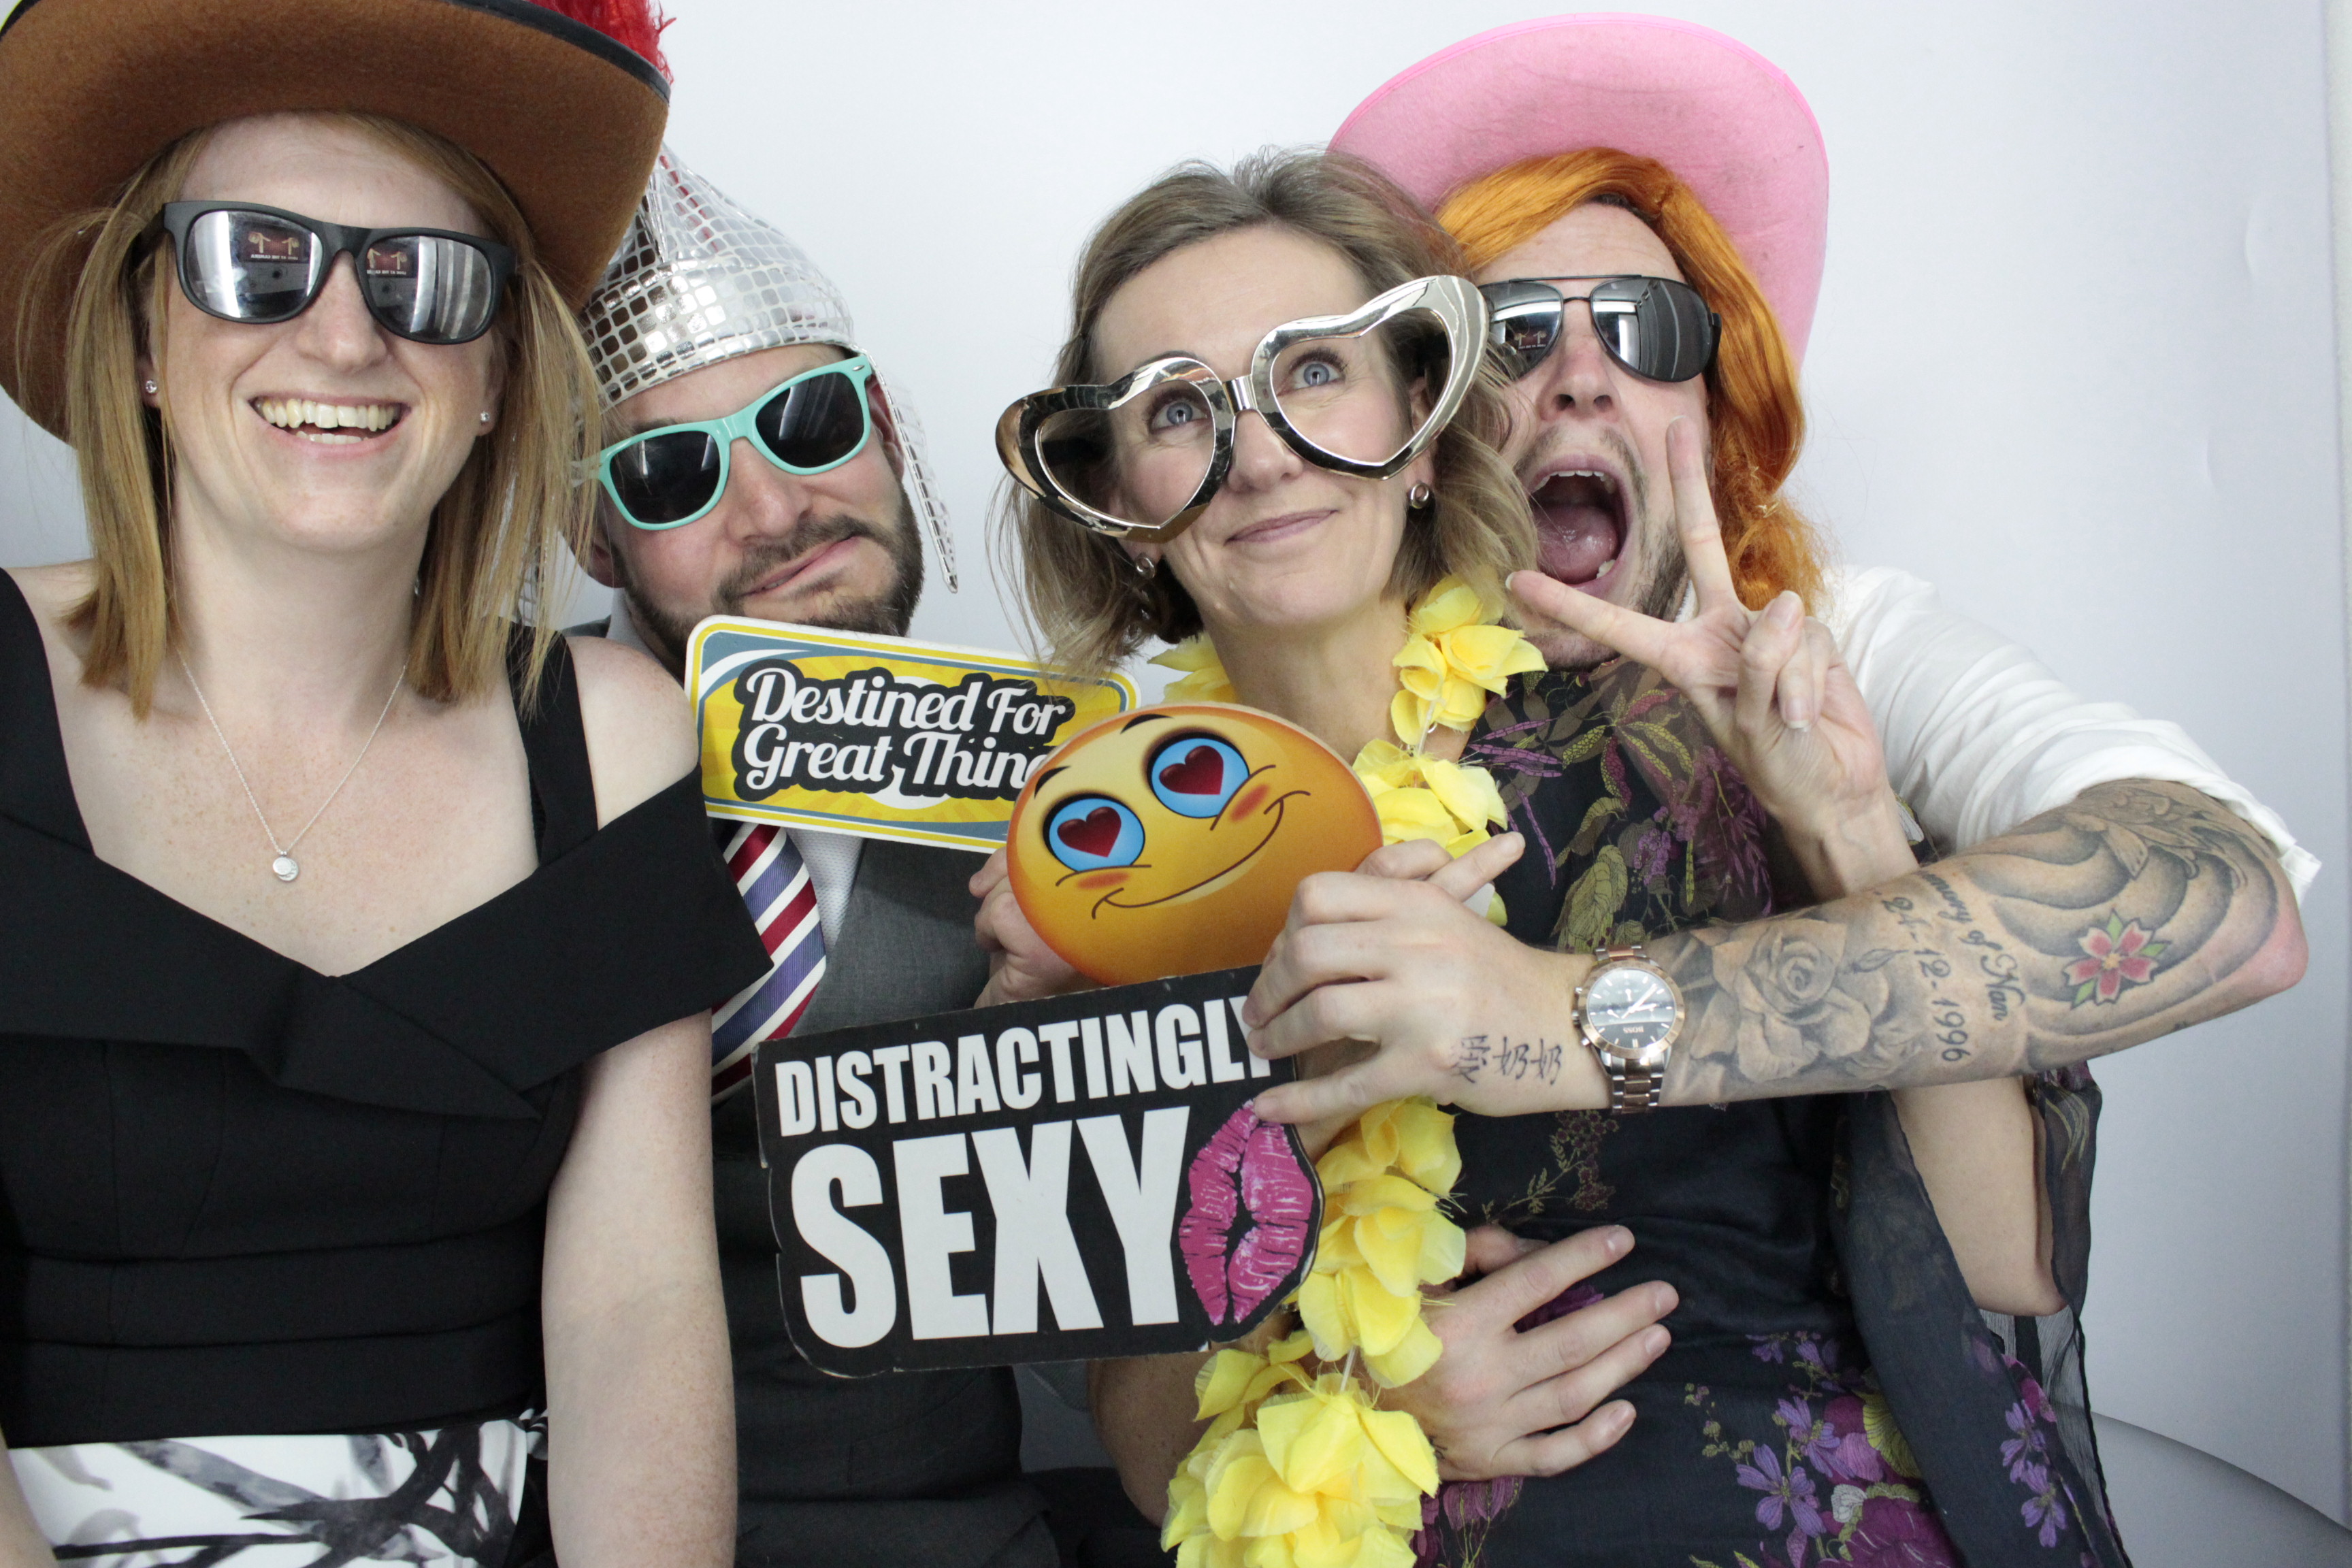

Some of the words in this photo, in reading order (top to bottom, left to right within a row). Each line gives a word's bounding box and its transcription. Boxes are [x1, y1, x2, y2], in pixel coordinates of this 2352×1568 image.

[746, 667, 983, 731] Destined
[986, 687, 1066, 736] For
[743, 723, 893, 790] Great
[903, 731, 1047, 789] Thin
[1622, 1026, 1644, 1034] BOSS
[791, 1106, 1191, 1348] SEXY
